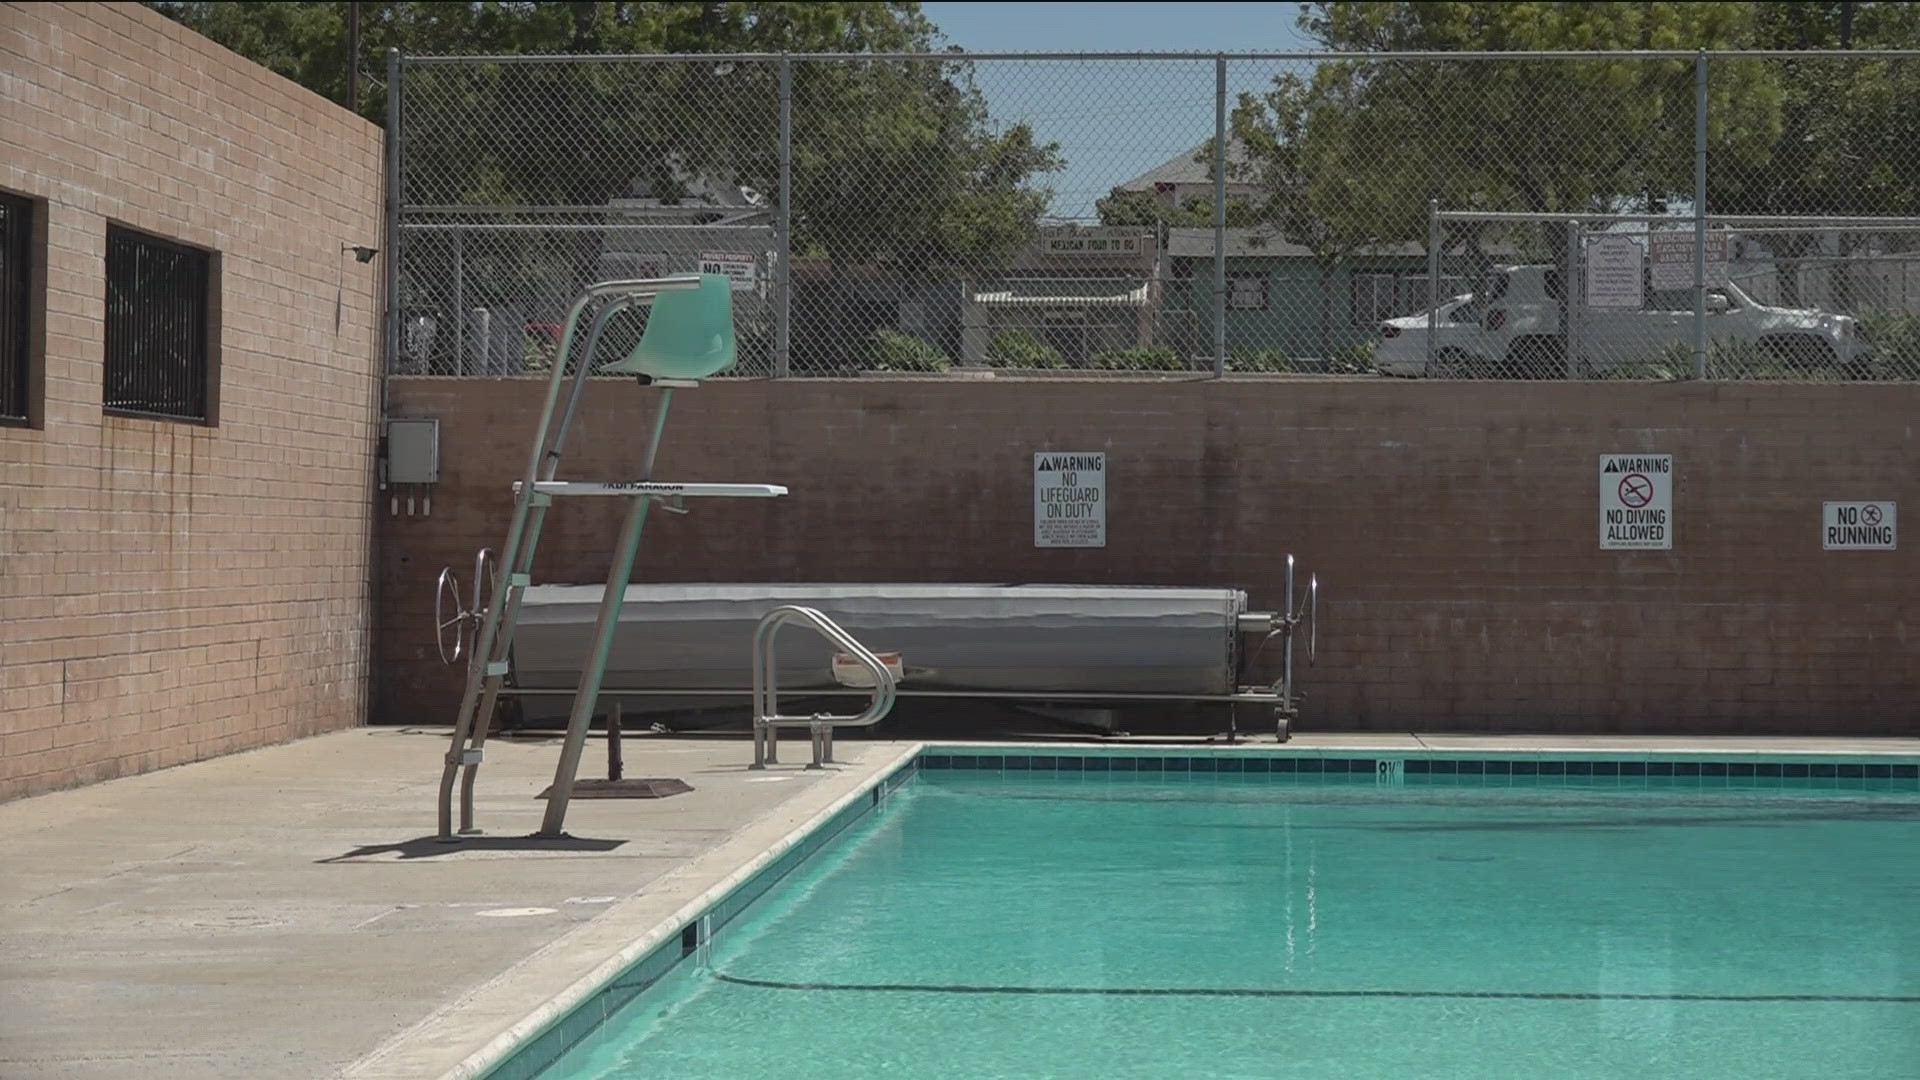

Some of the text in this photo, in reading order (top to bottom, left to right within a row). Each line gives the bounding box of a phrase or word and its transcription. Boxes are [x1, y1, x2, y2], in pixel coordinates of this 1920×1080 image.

[1050, 239, 1134, 250] MEXICAN FOOD TO GO
[703, 263, 721, 275] NO
[1052, 456, 1102, 471] WARNING
[1618, 458, 1669, 473] WARNING
[1062, 472, 1077, 487] NO
[1040, 487, 1099, 502] LIFEGUARD
[1047, 503, 1093, 518] ON DUTY
[1606, 509, 1666, 524] NO DIVING
[1838, 507, 1857, 525] NO
[1607, 525, 1664, 540] ALLOWED
[1828, 526, 1892, 544] RUNNING
